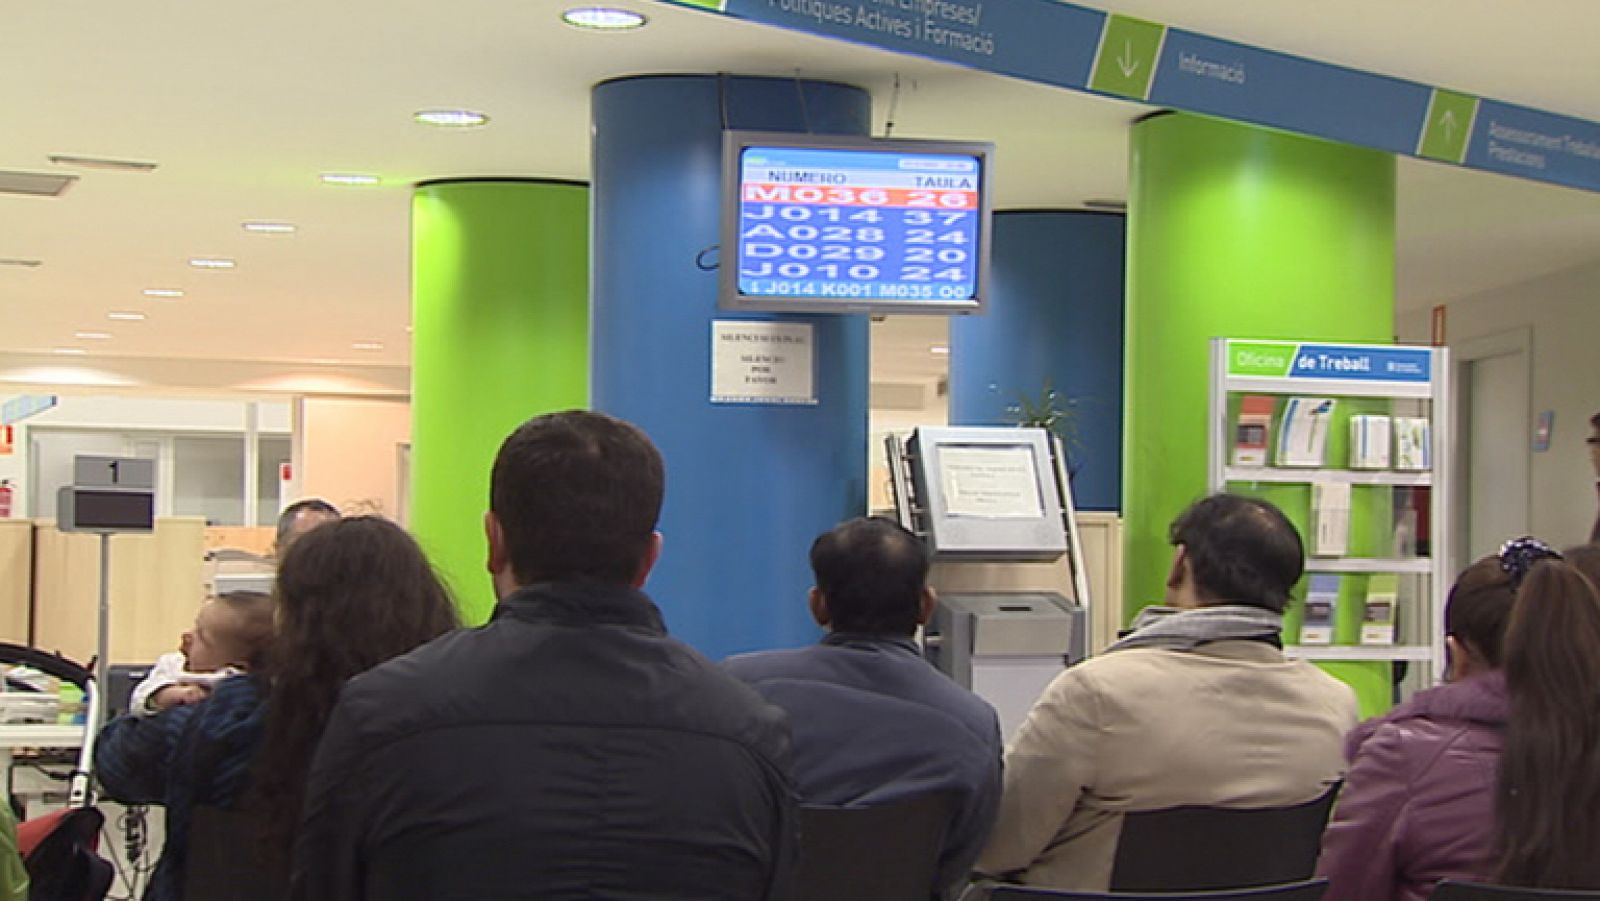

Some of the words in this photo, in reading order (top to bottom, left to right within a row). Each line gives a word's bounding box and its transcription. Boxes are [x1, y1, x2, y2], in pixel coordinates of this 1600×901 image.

[915, 175, 971, 189] TAULA
[744, 186, 889, 205] M036
[906, 192, 968, 208] 26
[743, 206, 882, 223] J014
[903, 210, 967, 225] 37
[743, 224, 885, 242] A028
[904, 229, 969, 245] 24
[745, 243, 885, 261] D029
[904, 248, 968, 263] 20
[741, 262, 880, 280] J010
[900, 266, 968, 281] 24
[765, 281, 815, 295] J014
[822, 283, 872, 296] K001
[1298, 354, 1316, 369] de
[1319, 354, 1369, 372] Treball
[108, 460, 119, 484] 1
